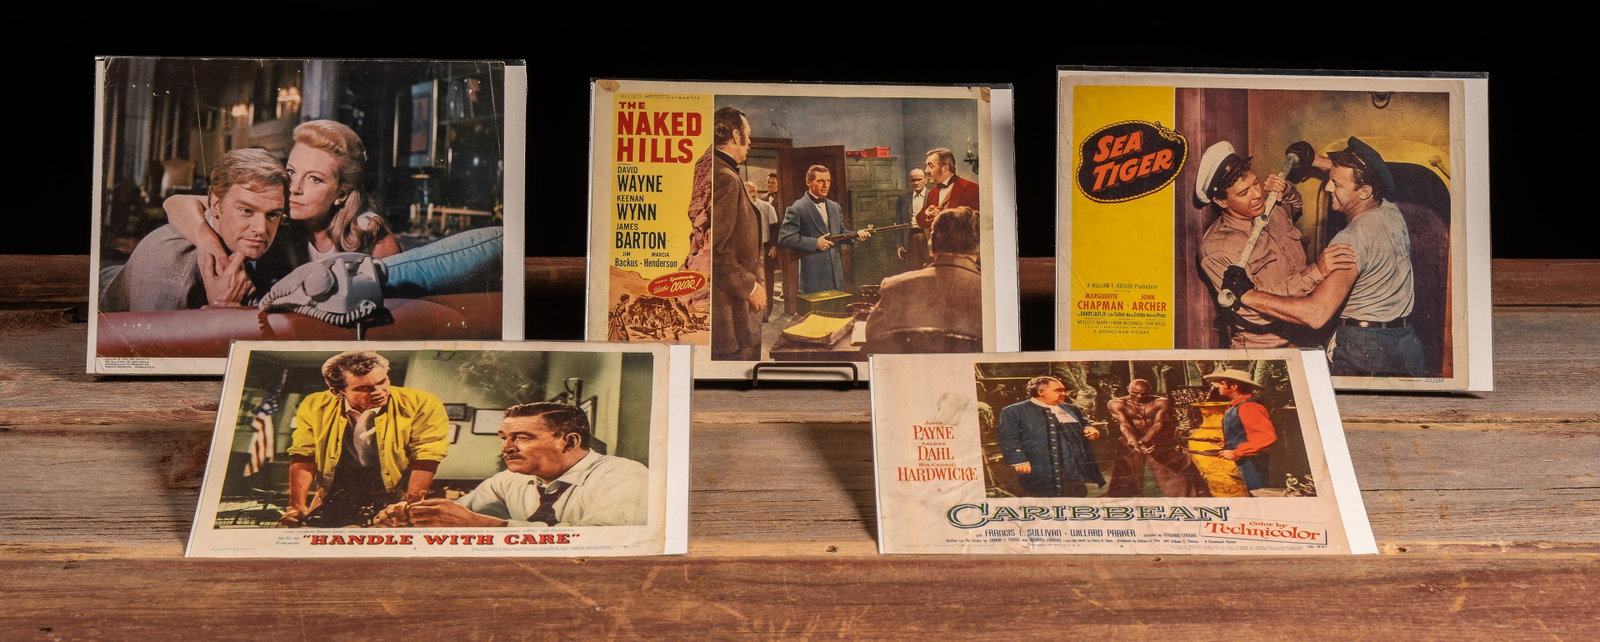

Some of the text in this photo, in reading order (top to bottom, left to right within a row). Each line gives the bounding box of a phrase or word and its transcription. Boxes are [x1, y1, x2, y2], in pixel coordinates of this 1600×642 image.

[618, 111, 702, 136] NAKED
[617, 138, 694, 164] HILLS
[1093, 130, 1144, 162] SEA
[1092, 148, 1174, 192] TIGER
[618, 174, 663, 192] WAYNE
[616, 204, 656, 220] WYNN
[616, 232, 666, 249] BARTON
[615, 258, 638, 268] Backus
[644, 258, 678, 268] Henderson
[670, 278, 702, 292] COLOR!
[1077, 300, 1166, 312] CHAPMAN ARCHER
[912, 426, 954, 440] PAYNE
[916, 446, 954, 460] DAHL
[898, 466, 978, 482] HARDWICKE
[945, 502, 1230, 529] CARIBBEAN
[1204, 522, 1320, 540] Technicolor
[1275, 520, 1288, 529] by
[303, 533, 580, 546] "HANDLE WITH CARE"
[1028, 529, 1062, 537] SULLIVAN
[1107, 529, 1136, 537] PARKER
